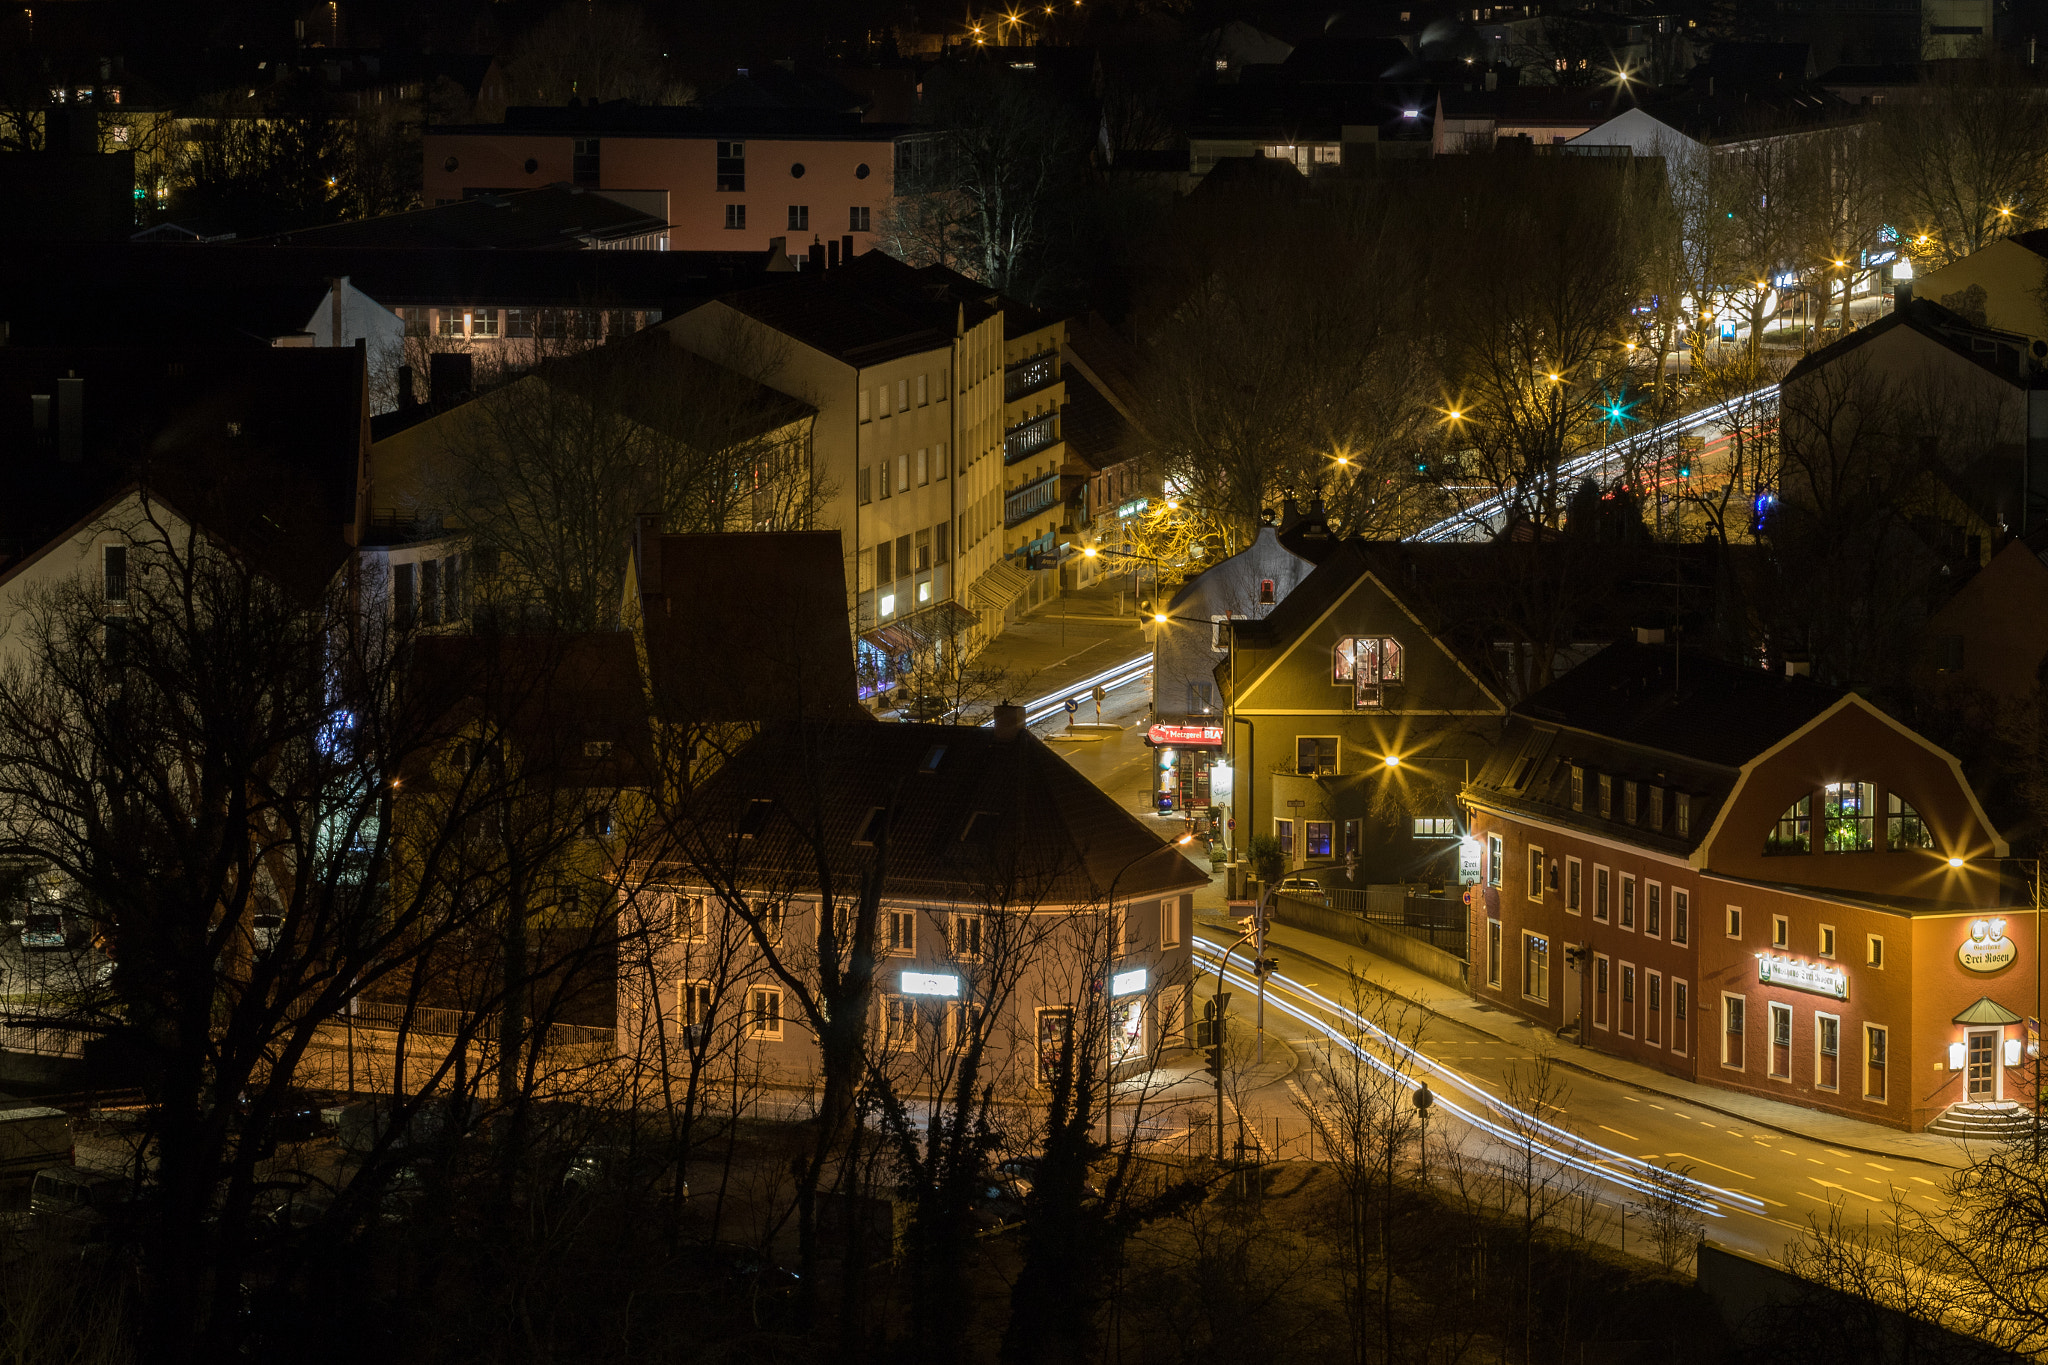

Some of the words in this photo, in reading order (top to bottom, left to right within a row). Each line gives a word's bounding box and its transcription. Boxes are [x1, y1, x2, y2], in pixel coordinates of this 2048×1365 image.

[1170, 730, 1202, 739] Metzgerei
[1204, 730, 1223, 739] BLA
[1464, 860, 1477, 868] Drei
[1965, 953, 1983, 964] Drei
[1985, 953, 2009, 963] Rosen
